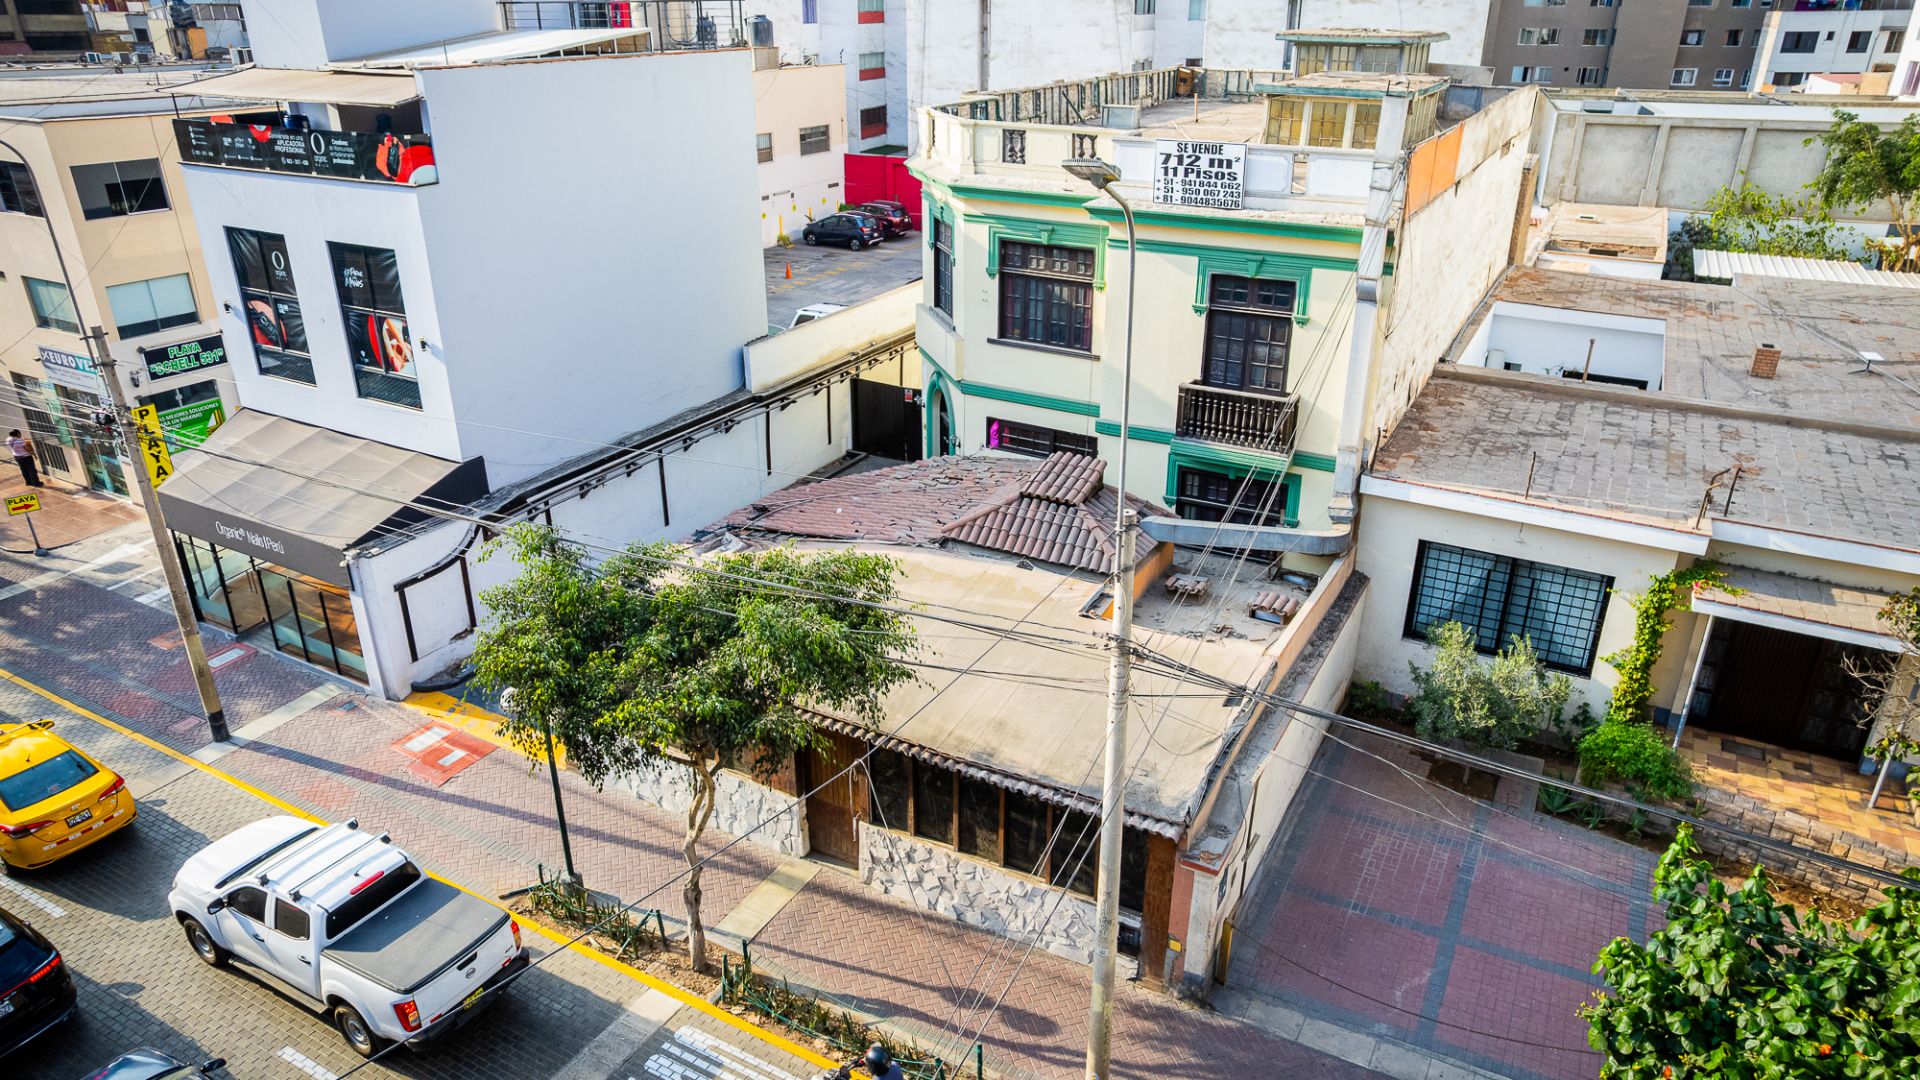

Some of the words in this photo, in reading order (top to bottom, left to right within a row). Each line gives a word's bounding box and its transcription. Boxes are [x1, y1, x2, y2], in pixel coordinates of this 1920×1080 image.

[276, 140, 305, 148] APLICADORA
[1177, 142, 1189, 153] SE
[1192, 144, 1224, 155] VENDE
[1160, 153, 1201, 167] 712
[1161, 166, 1178, 178] 11
[1184, 167, 1238, 182] Pisos
[1181, 179, 1197, 187] 941
[1199, 181, 1218, 189] 844
[1221, 182, 1241, 190] 662
[1182, 187, 1200, 196] 950
[1203, 189, 1220, 197] 067
[1223, 190, 1241, 199] 243
[168, 341, 202, 359] PLAYA
[48, 351, 97, 373] EUROVE
[165, 411, 189, 419] MEJORES
[189, 402, 219, 413] SOLUCIONES
[138, 409, 169, 479] PLAYA
[7, 495, 37, 506] PLAYA
